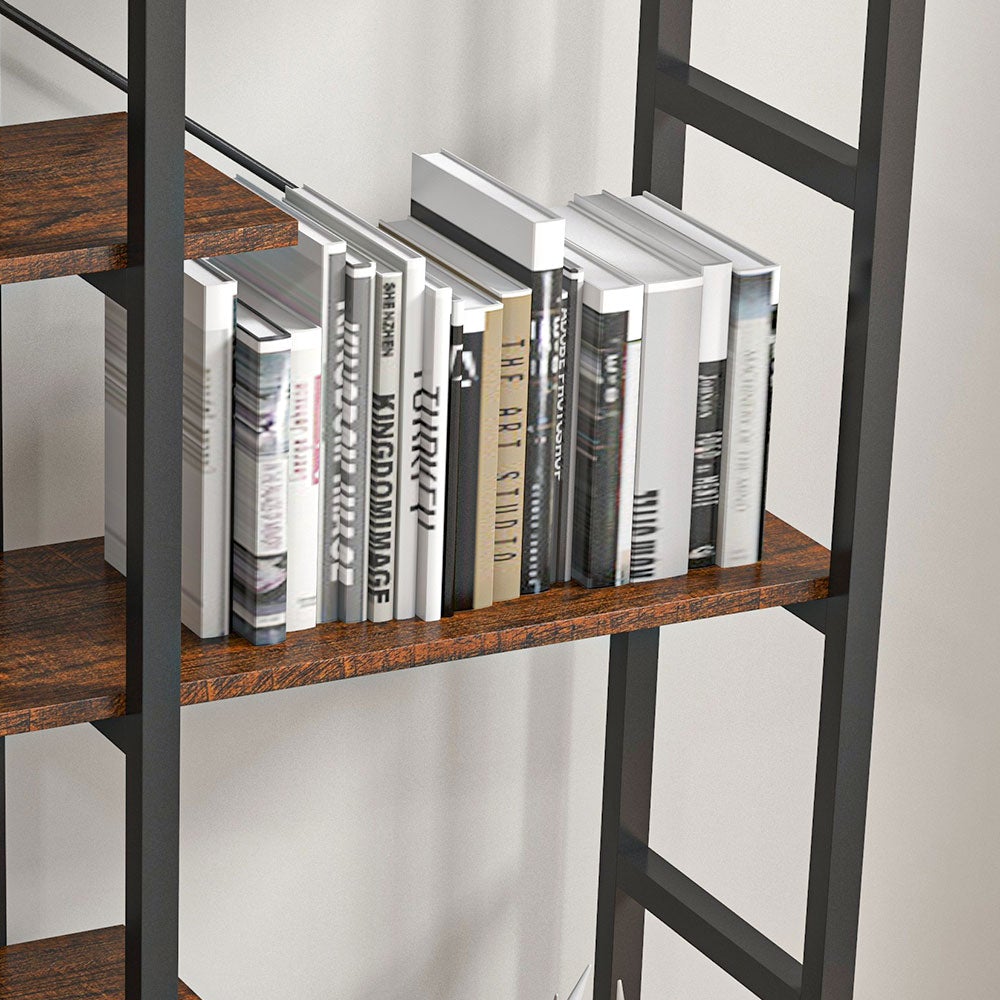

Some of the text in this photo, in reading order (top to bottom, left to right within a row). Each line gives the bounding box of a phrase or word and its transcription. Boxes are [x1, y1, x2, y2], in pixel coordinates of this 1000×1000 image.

[381, 281, 396, 358] SHENZHEN
[493, 338, 526, 562] THE ART STUDIO
